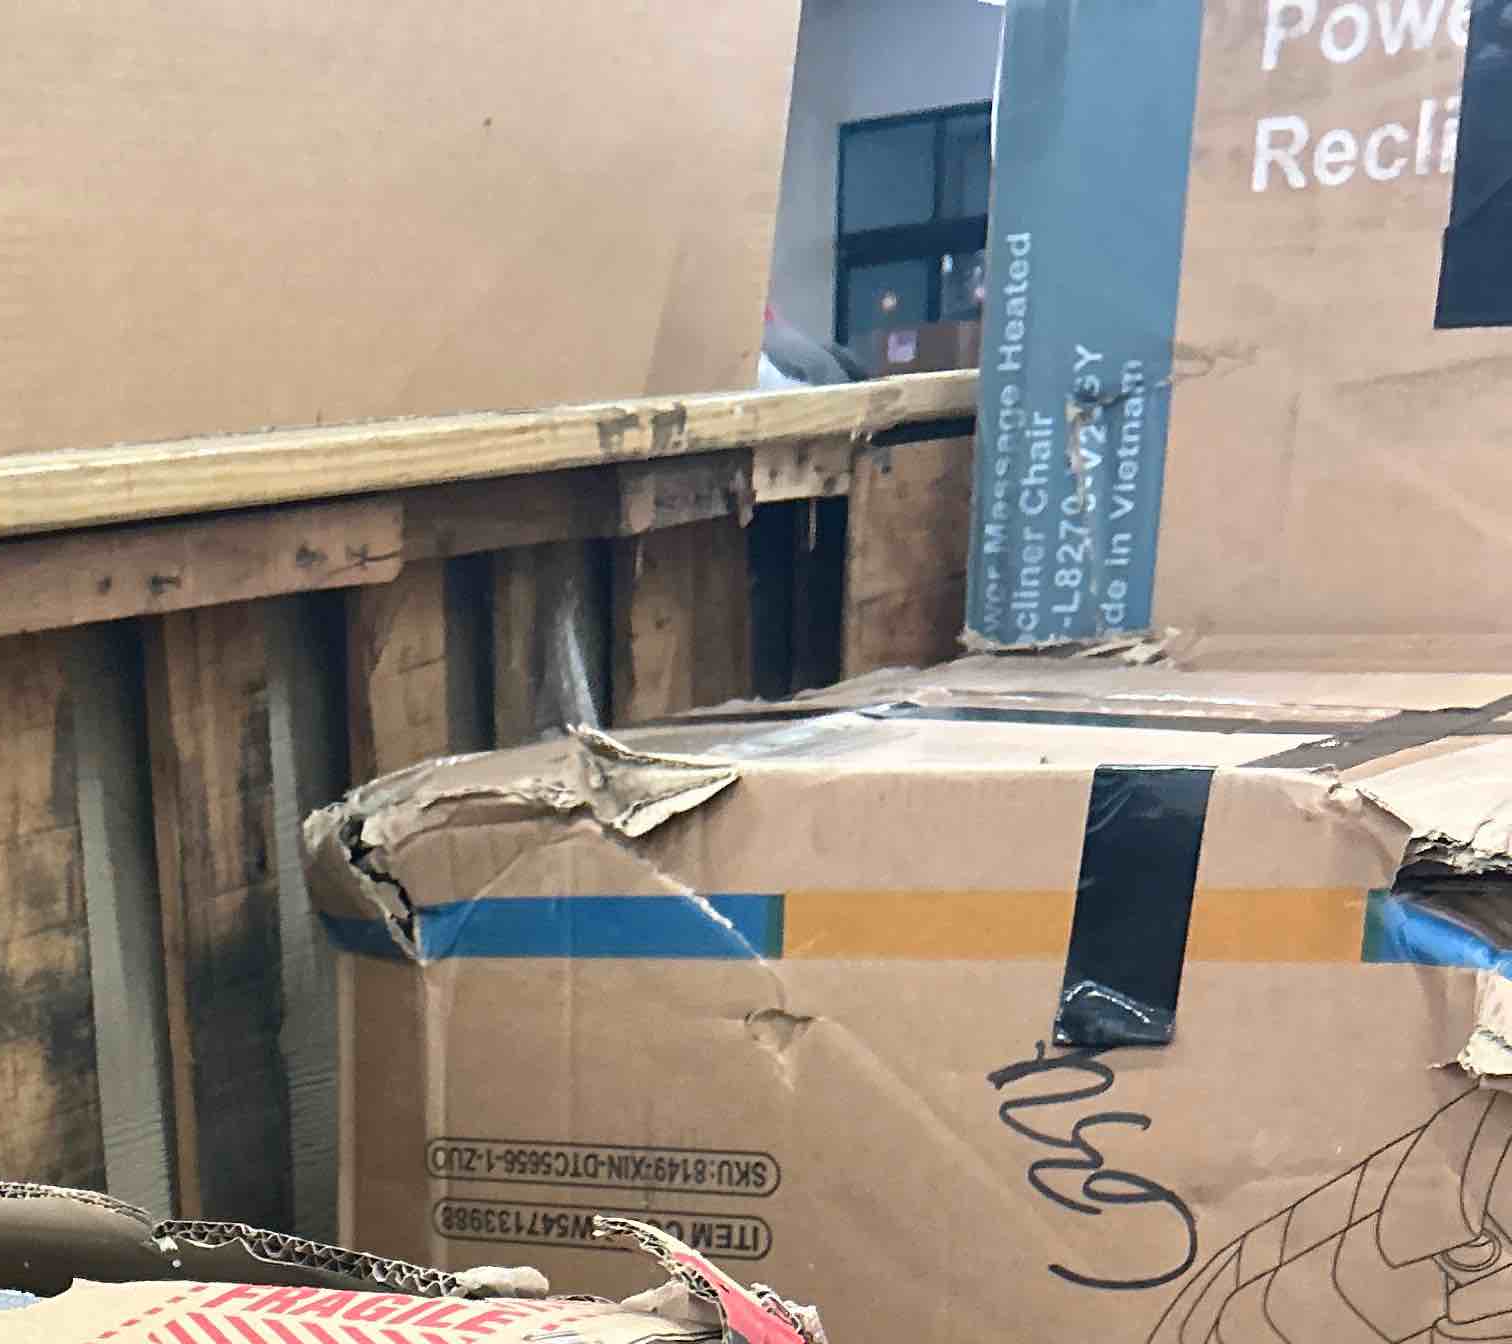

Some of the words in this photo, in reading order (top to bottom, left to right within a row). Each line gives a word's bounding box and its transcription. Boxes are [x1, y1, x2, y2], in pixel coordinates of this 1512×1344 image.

[1251, 96, 1461, 192] Recli
[997, 232, 1031, 371] Heated
[1018, 411, 1054, 516] Chair
[1109, 359, 1145, 520] Vietnam
[1011, 526, 1045, 642] cliner
[1104, 532, 1132, 566] in
[691, 1221, 760, 1251] ITEM
[200, 1283, 529, 1334] FRAGILE
